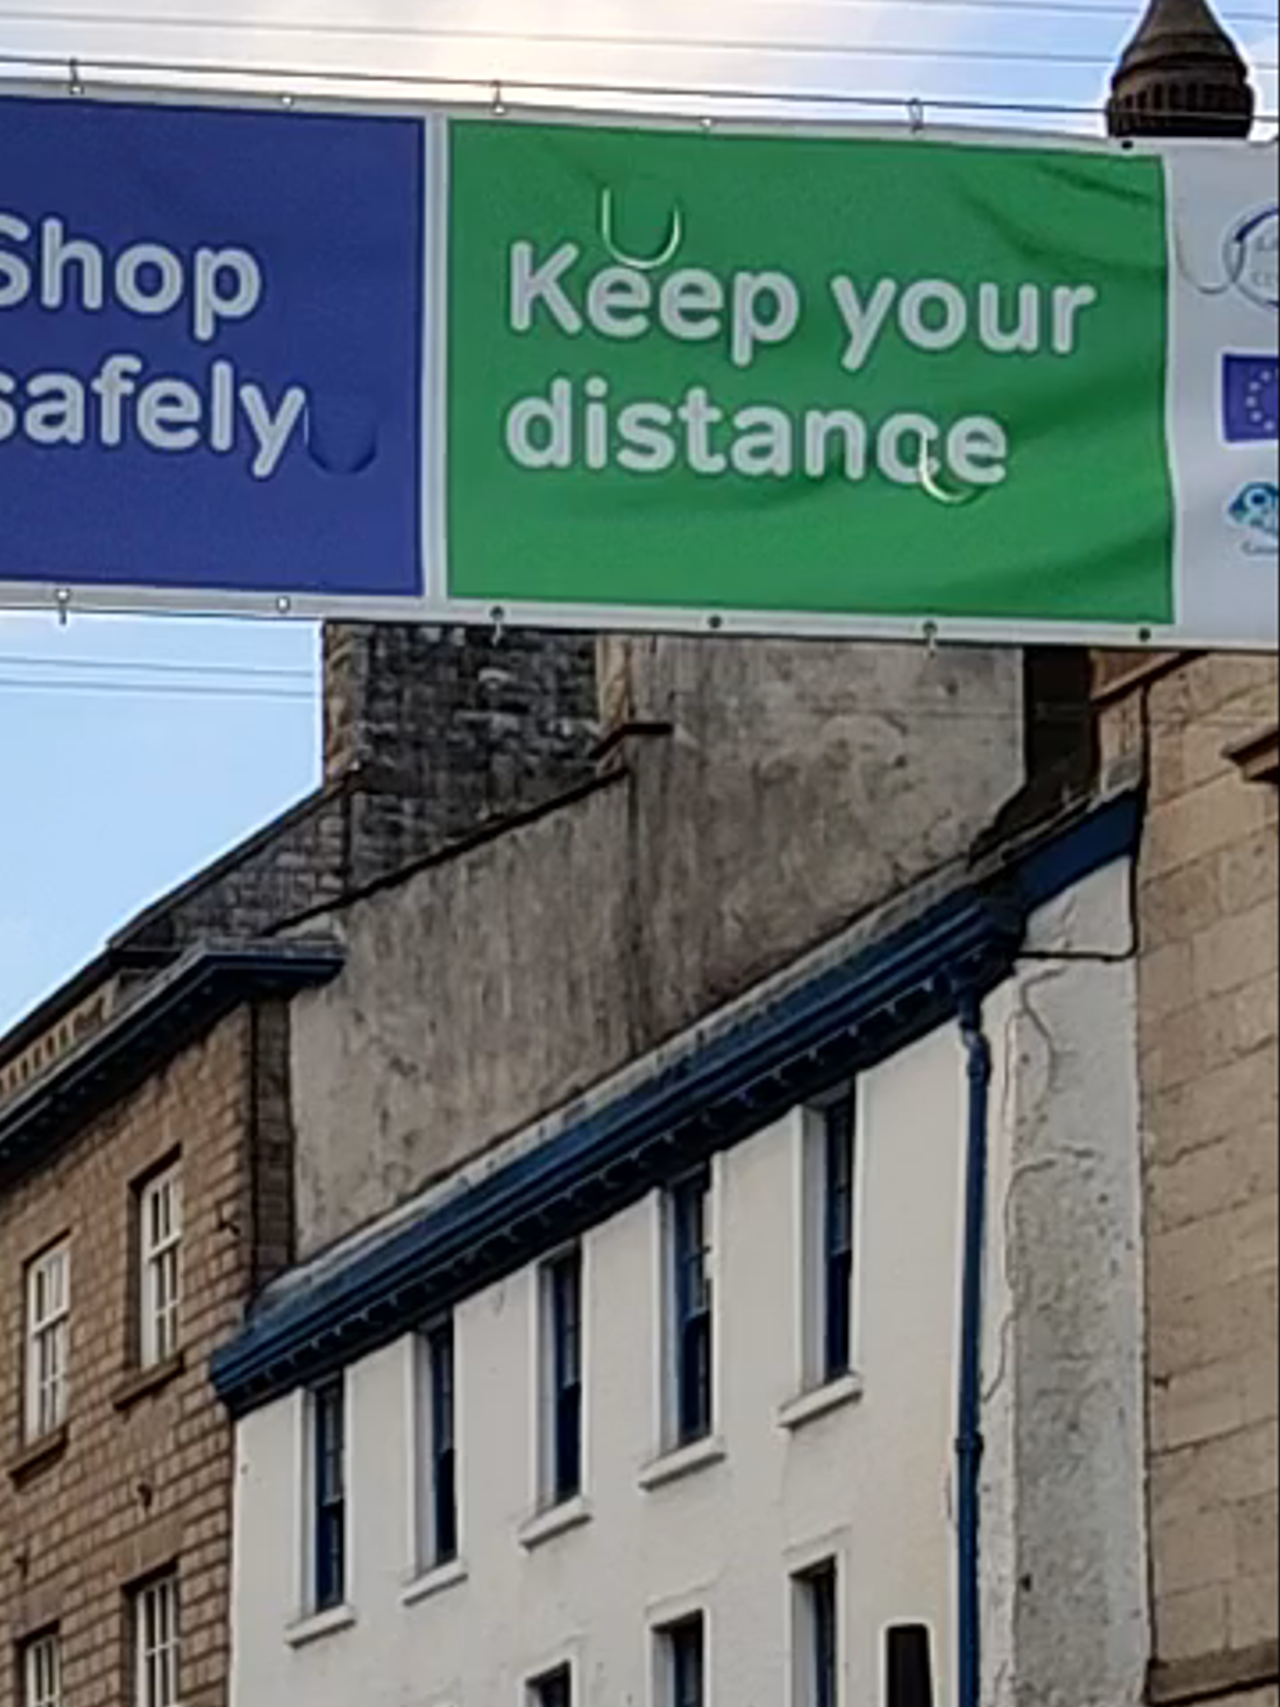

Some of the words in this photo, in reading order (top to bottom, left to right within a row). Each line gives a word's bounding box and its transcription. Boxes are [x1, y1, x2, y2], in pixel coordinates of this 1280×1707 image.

[509, 240, 800, 366] Keep
[831, 273, 1097, 371] your
[504, 376, 1007, 485] distance
